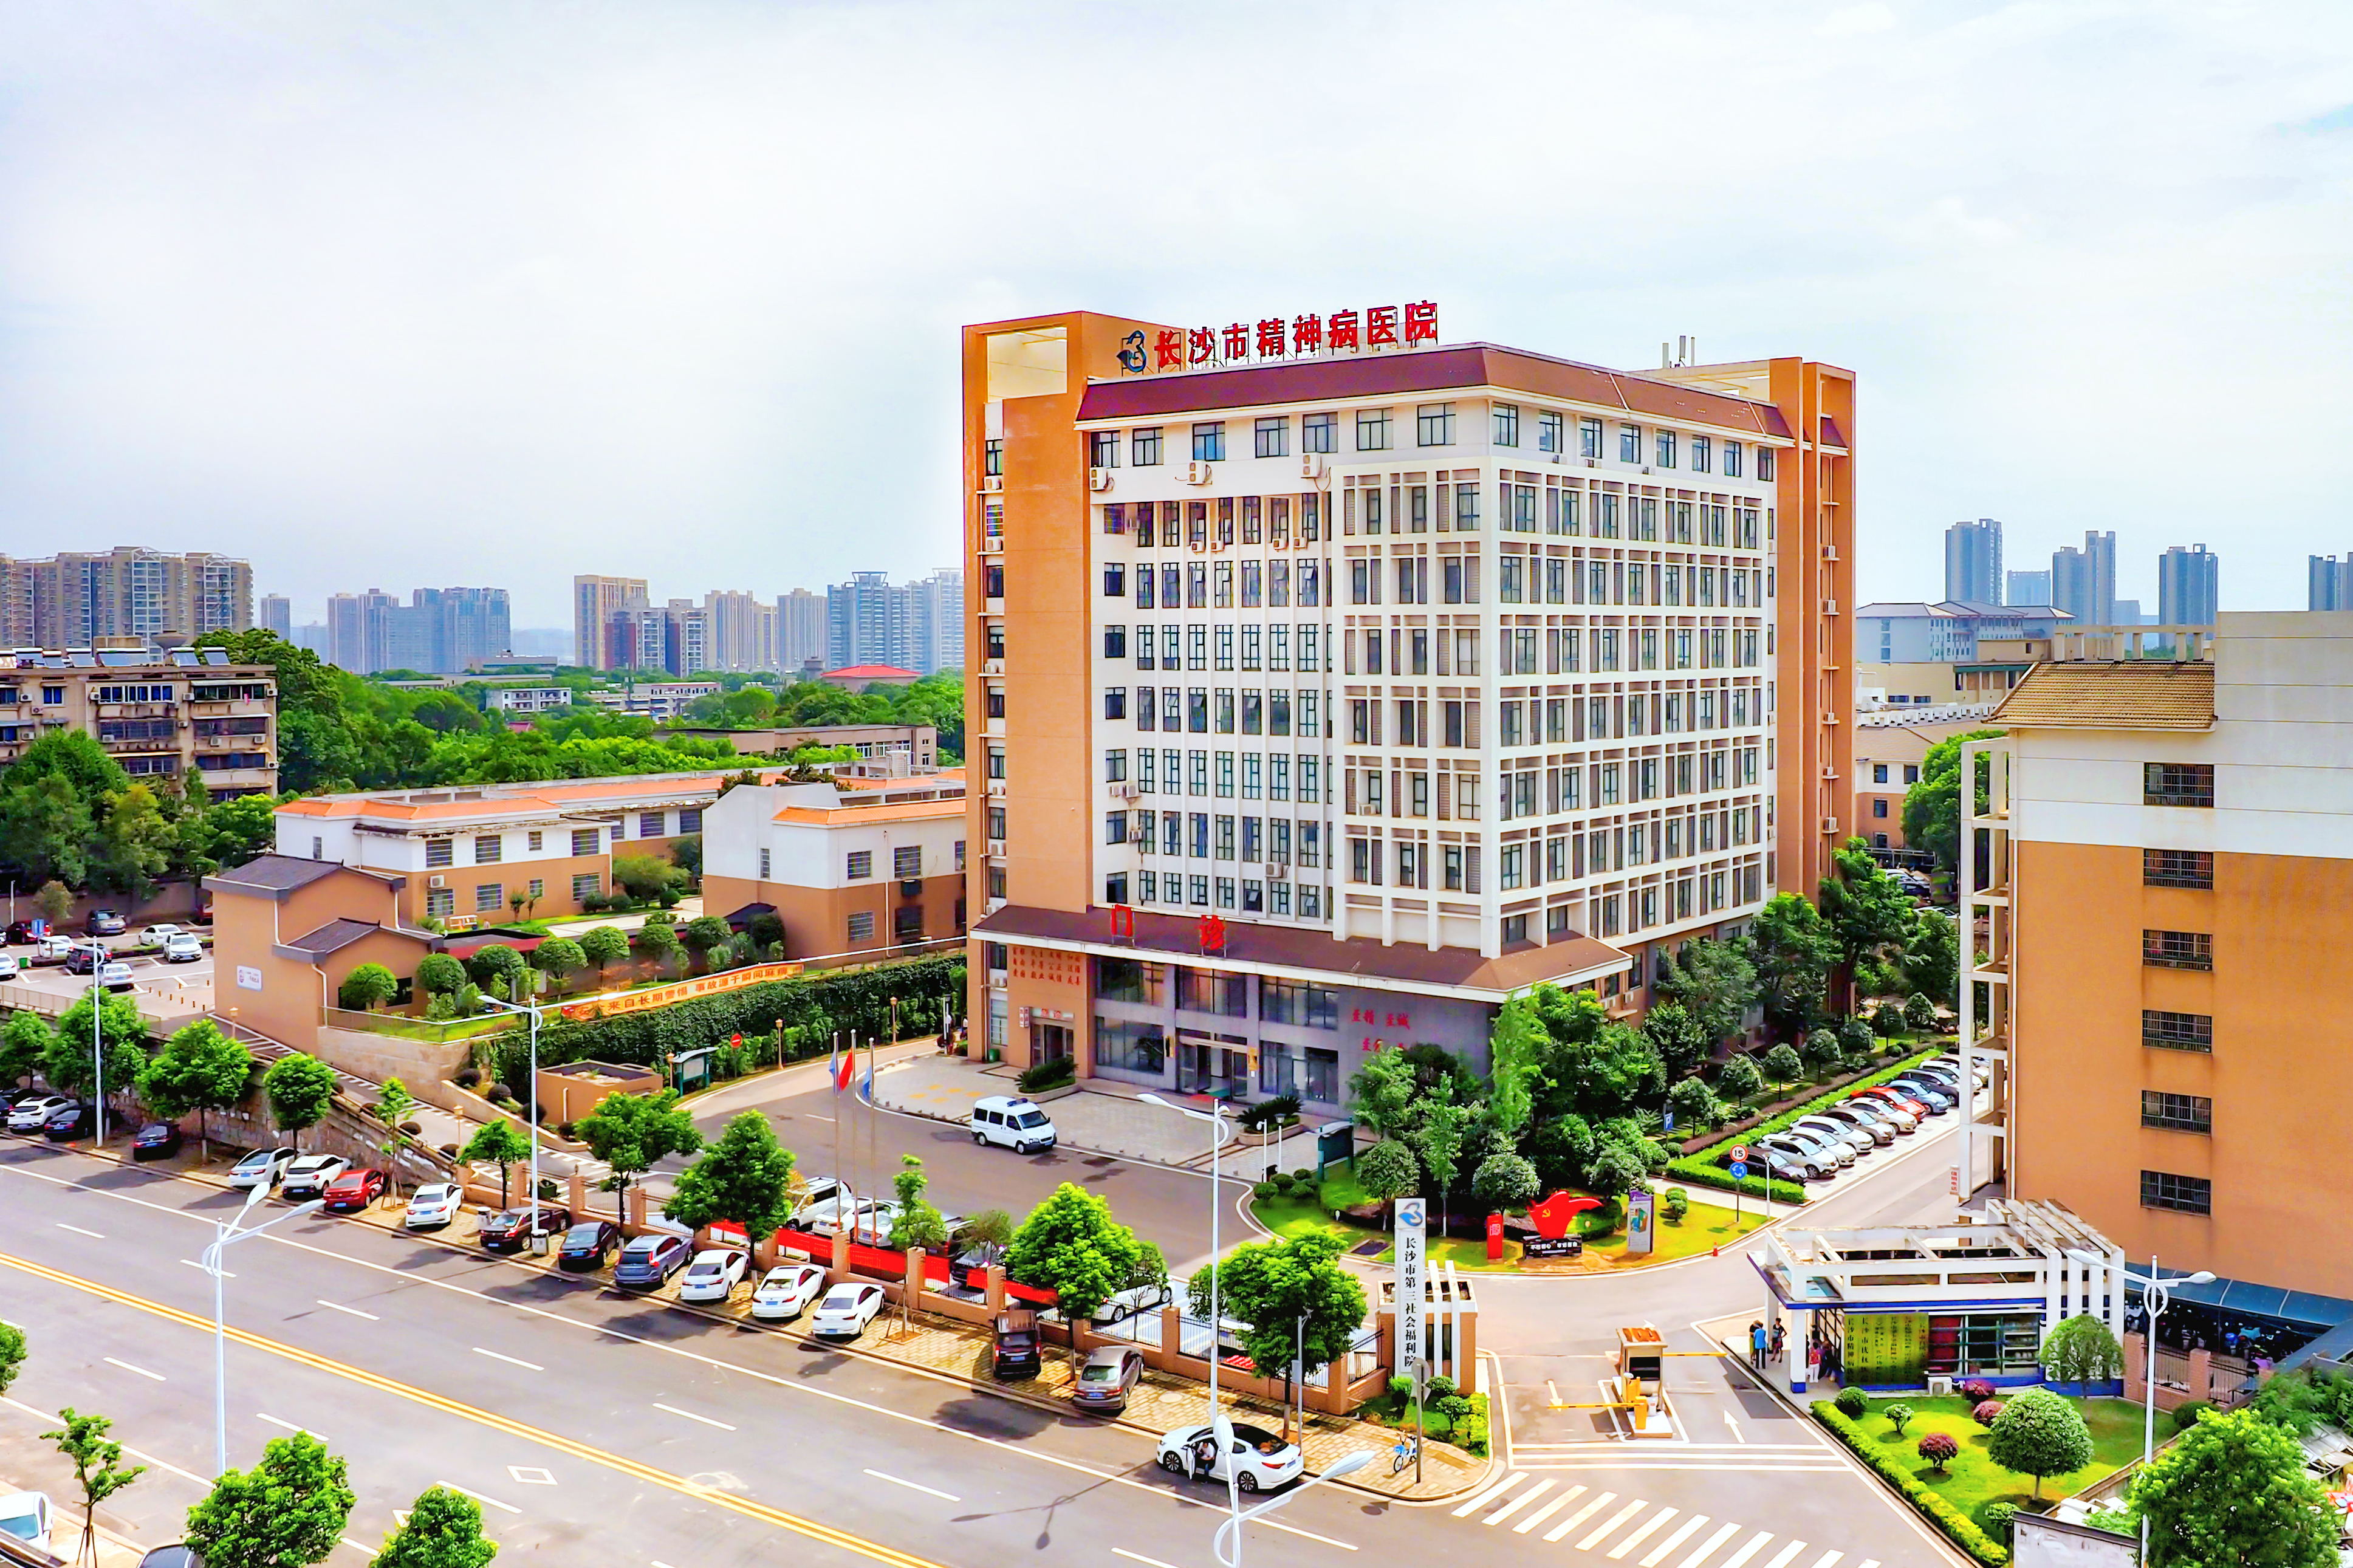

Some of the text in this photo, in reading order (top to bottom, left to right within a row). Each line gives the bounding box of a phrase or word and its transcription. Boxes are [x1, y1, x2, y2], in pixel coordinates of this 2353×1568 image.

[1154, 300, 1438, 368] 长沙市精神病医院
[1665, 1116, 1671, 1129] P
[1404, 1238, 1417, 1367] 长沙市第三社会福利院
